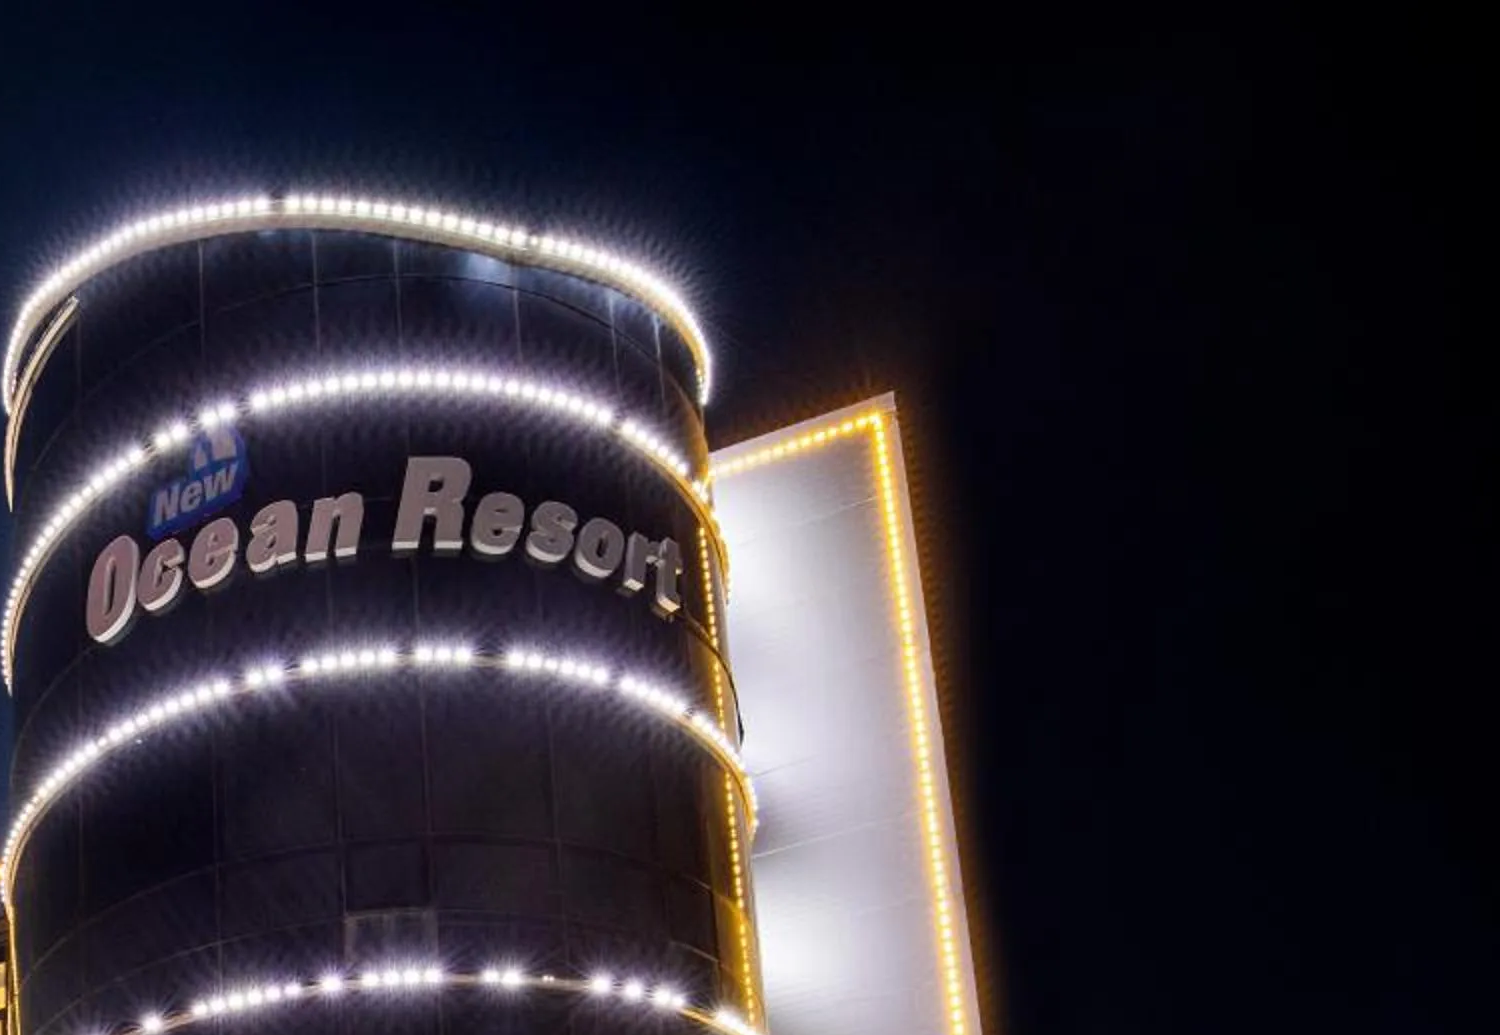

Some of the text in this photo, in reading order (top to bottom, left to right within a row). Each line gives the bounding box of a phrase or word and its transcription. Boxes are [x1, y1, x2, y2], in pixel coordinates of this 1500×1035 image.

[86, 456, 682, 643] Ocean Resort
[153, 461, 238, 527] New
